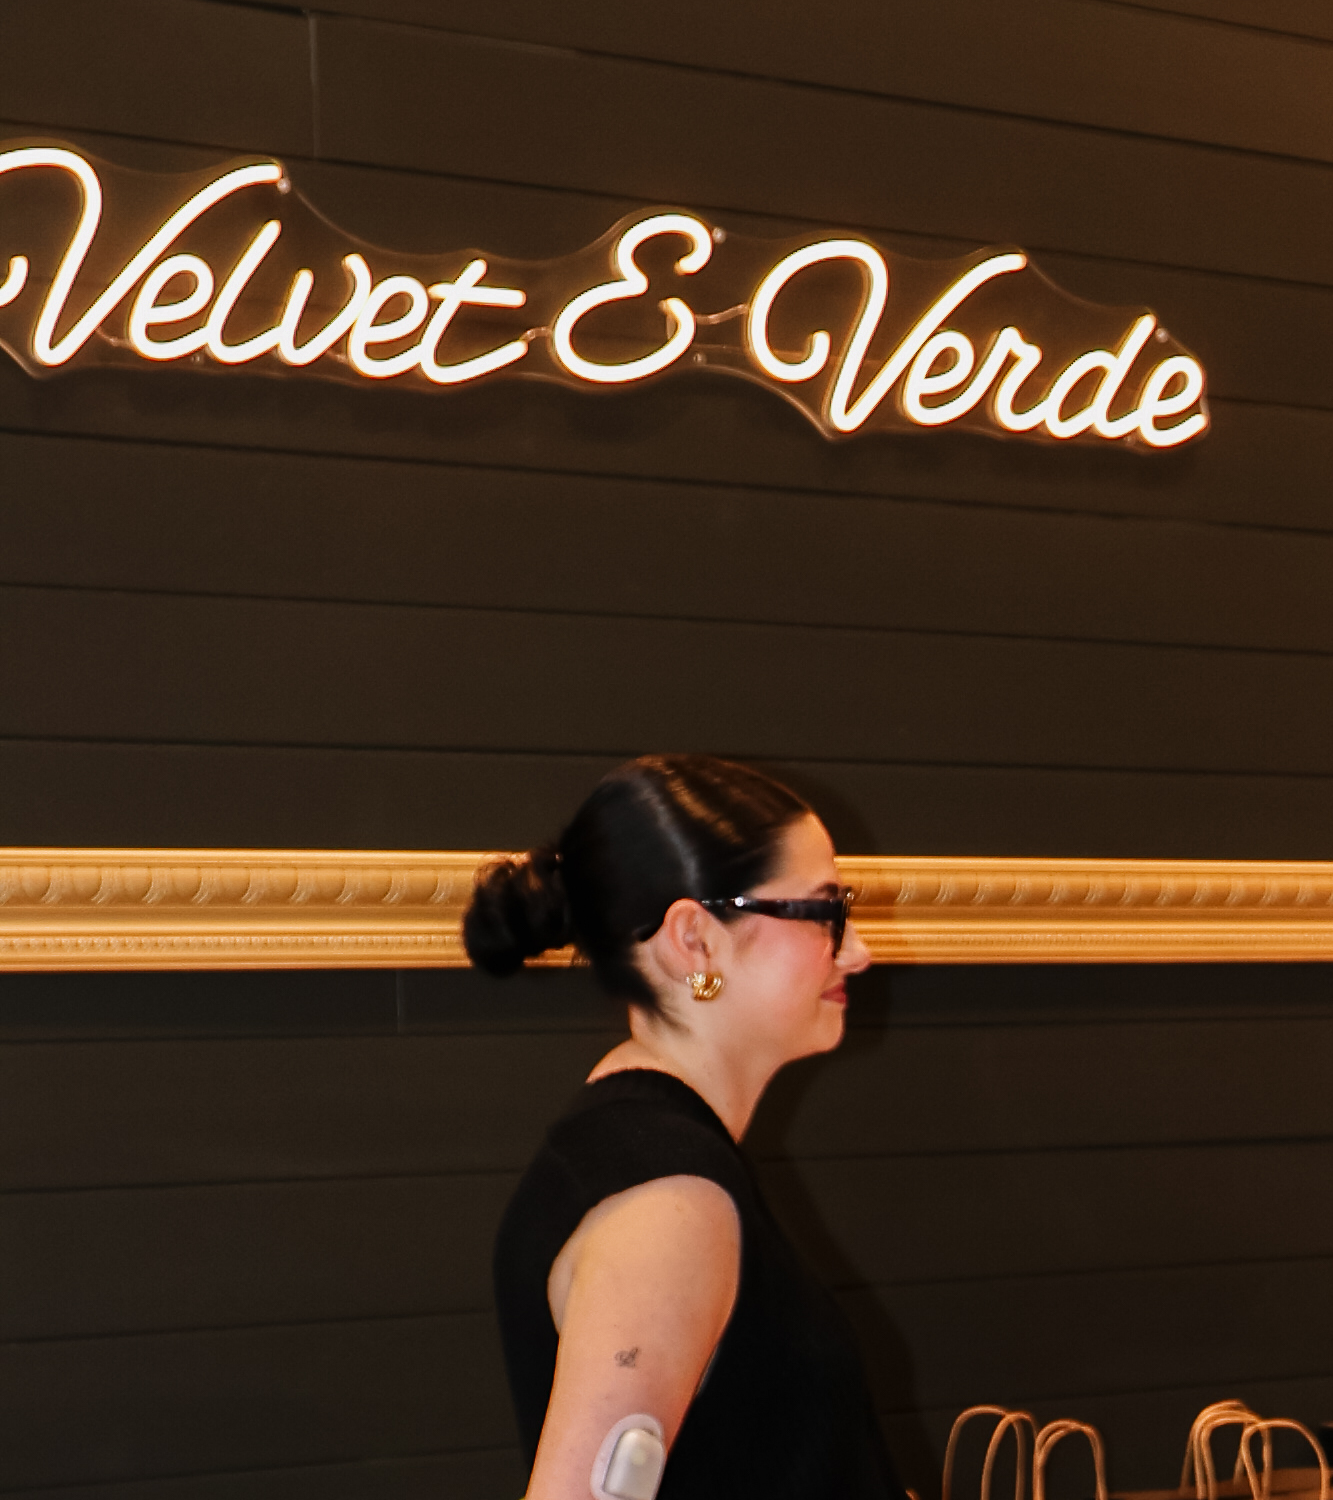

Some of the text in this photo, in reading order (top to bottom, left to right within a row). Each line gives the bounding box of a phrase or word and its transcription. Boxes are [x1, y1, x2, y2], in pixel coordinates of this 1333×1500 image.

[0, 145, 1210, 446] Velvet & Verde
